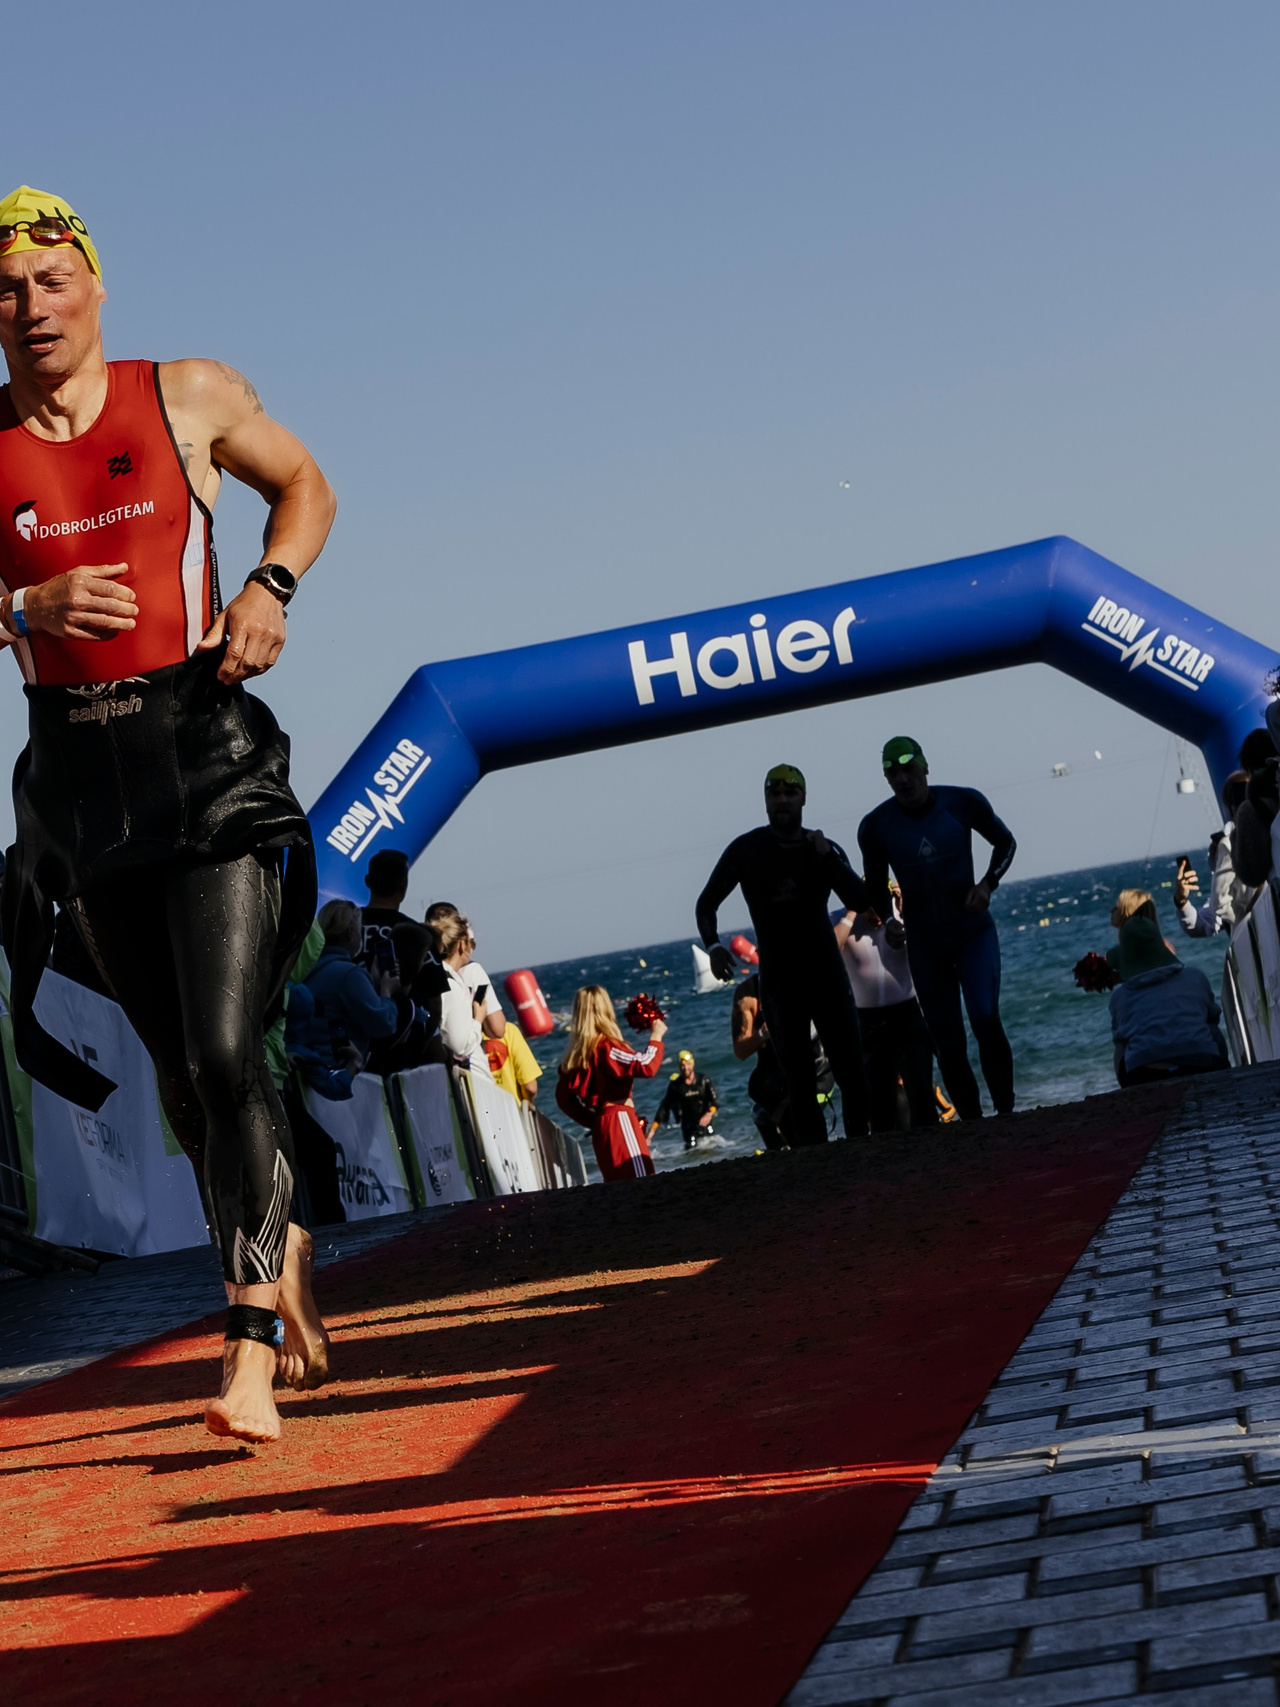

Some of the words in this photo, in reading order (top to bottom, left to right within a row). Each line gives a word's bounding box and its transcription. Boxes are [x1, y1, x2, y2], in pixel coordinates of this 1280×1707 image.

[39, 500, 156, 539] DOBROLEGTEAM
[627, 606, 857, 706] Haier
[1086, 595, 1146, 644] IRON
[1156, 634, 1216, 684] STAR
[325, 799, 377, 856] IRON
[372, 738, 425, 794] STAR
